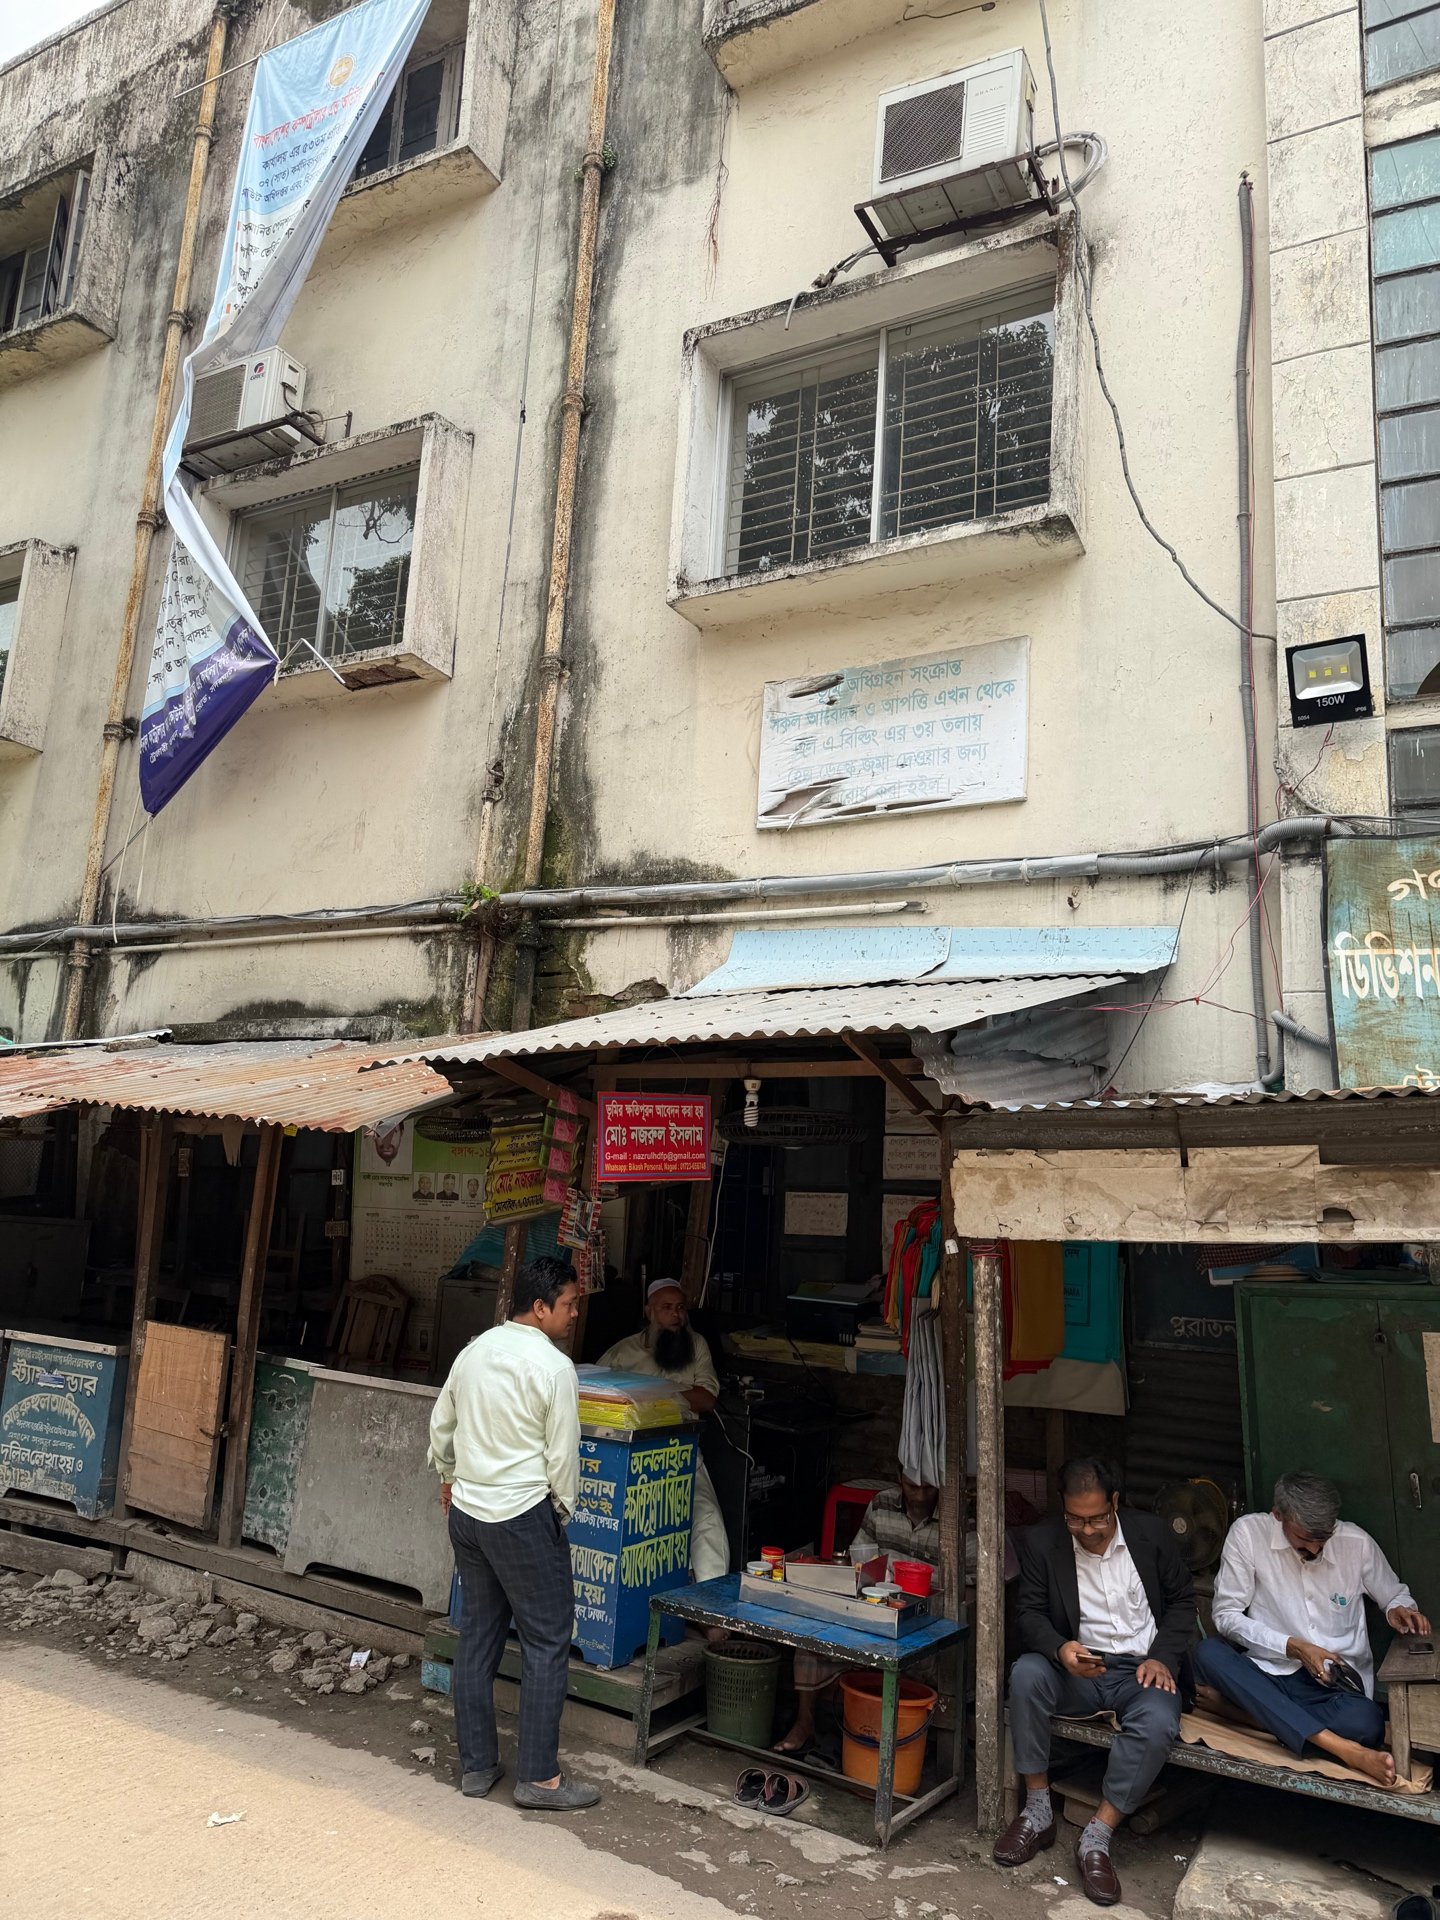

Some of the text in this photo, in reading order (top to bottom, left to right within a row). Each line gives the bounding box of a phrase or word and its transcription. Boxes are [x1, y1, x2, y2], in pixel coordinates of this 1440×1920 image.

[910, 659, 965, 684] সংক্রান্ত
[769, 679, 1017, 734] সকল আবেদন ও আপত্তি এখন থেকে
[1315, 693, 1346, 708] 150W
[840, 724, 880, 751] বিল্ডিং
[884, 724, 908, 743] এর
[912, 719, 936, 738] ৩য়
[940, 713, 984, 734] তলায়
[862, 752, 894, 774] জমা
[896, 746, 952, 769] দেওয়ার
[956, 742, 990, 762] জন্য
[605, 1099, 624, 1121] ভূমির
[655, 1104, 680, 1118] আবেদন
[681, 1104, 694, 1118] করা
[694, 1105, 704, 1120] হয়
[605, 1120, 704, 1149] মোঃ নজরুল ইসলাম
[605, 1151, 628, 1160] G-mail
[495, 1172, 514, 1194] মোঃ
[96, 1361, 104, 1371] ও
[18, 1393, 50, 1417] রুহুল
[49, 1392, 80, 1428] আমিন
[78, 1411, 97, 1448] খান
[75, 1458, 84, 1473] ও
[630, 1438, 694, 1475] অনলাইনে
[664, 1470, 694, 1528] বিলের
[577, 1546, 618, 1585] আবেদন
